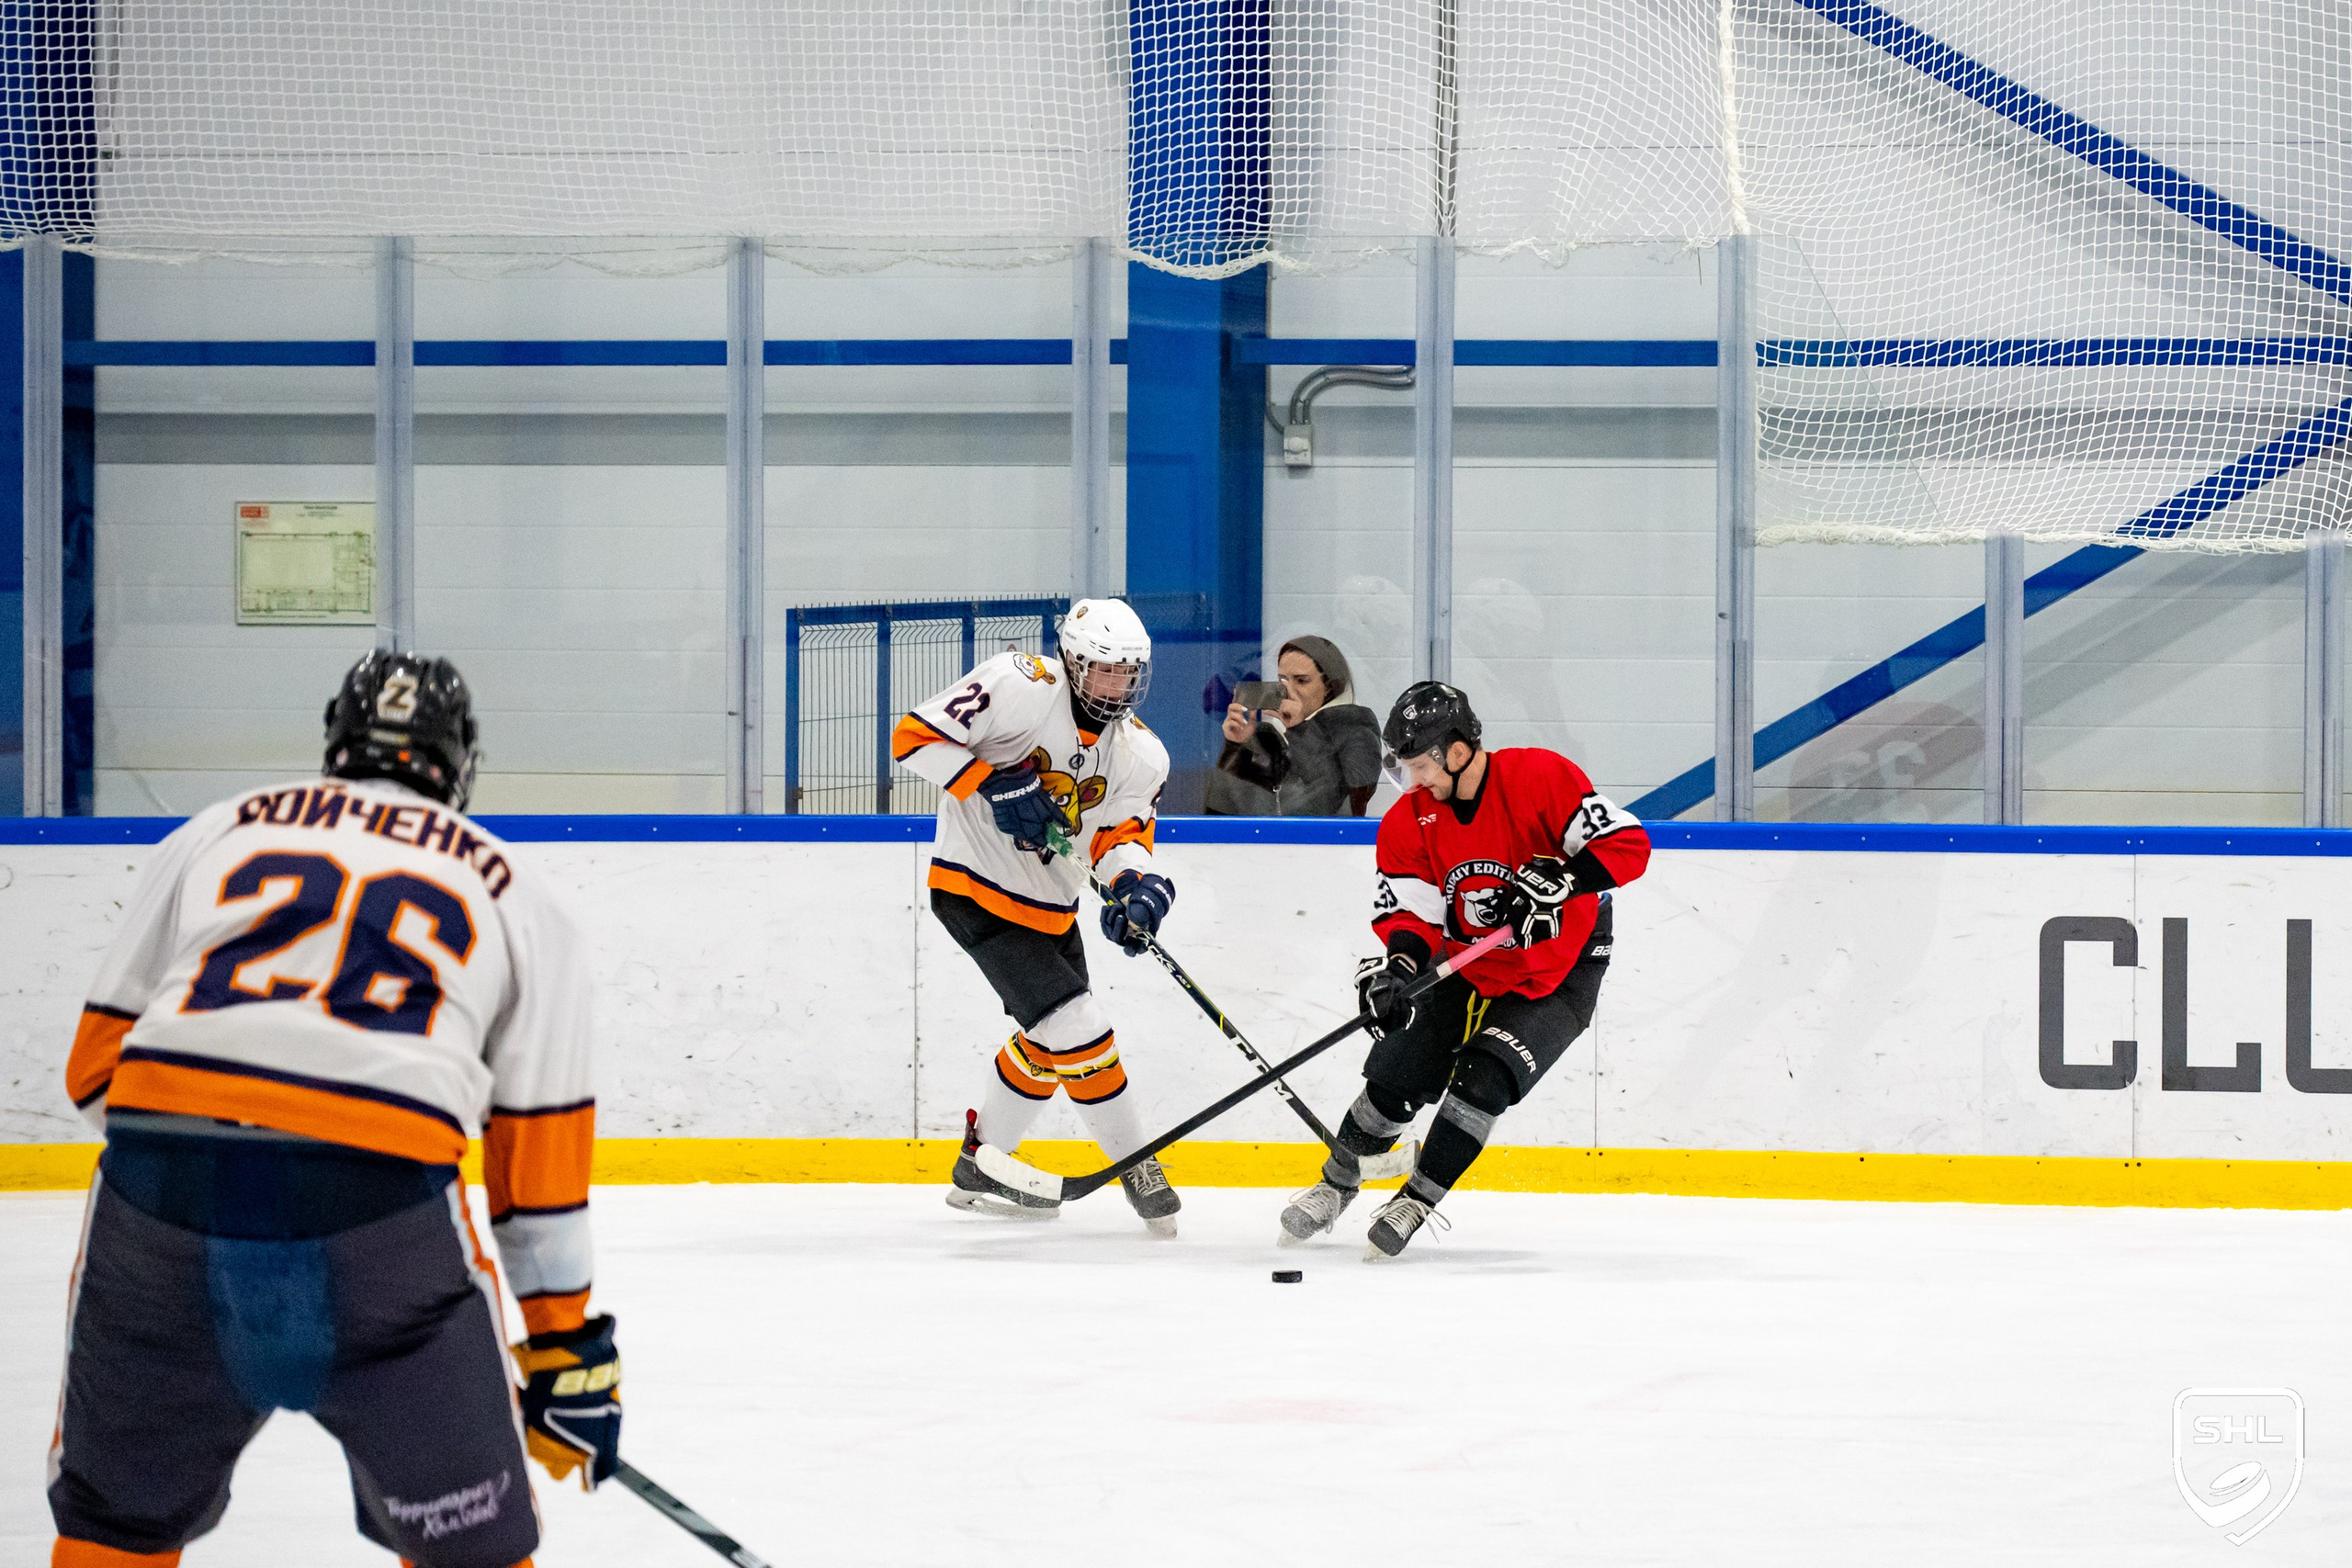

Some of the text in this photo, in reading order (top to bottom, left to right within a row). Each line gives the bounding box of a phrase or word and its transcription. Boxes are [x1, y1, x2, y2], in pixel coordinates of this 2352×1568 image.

[944, 682, 990, 730] 22
[179, 849, 478, 1038] 26
[1481, 1026, 1536, 1075] BAUER
[2039, 916, 2352, 1094] CLU
